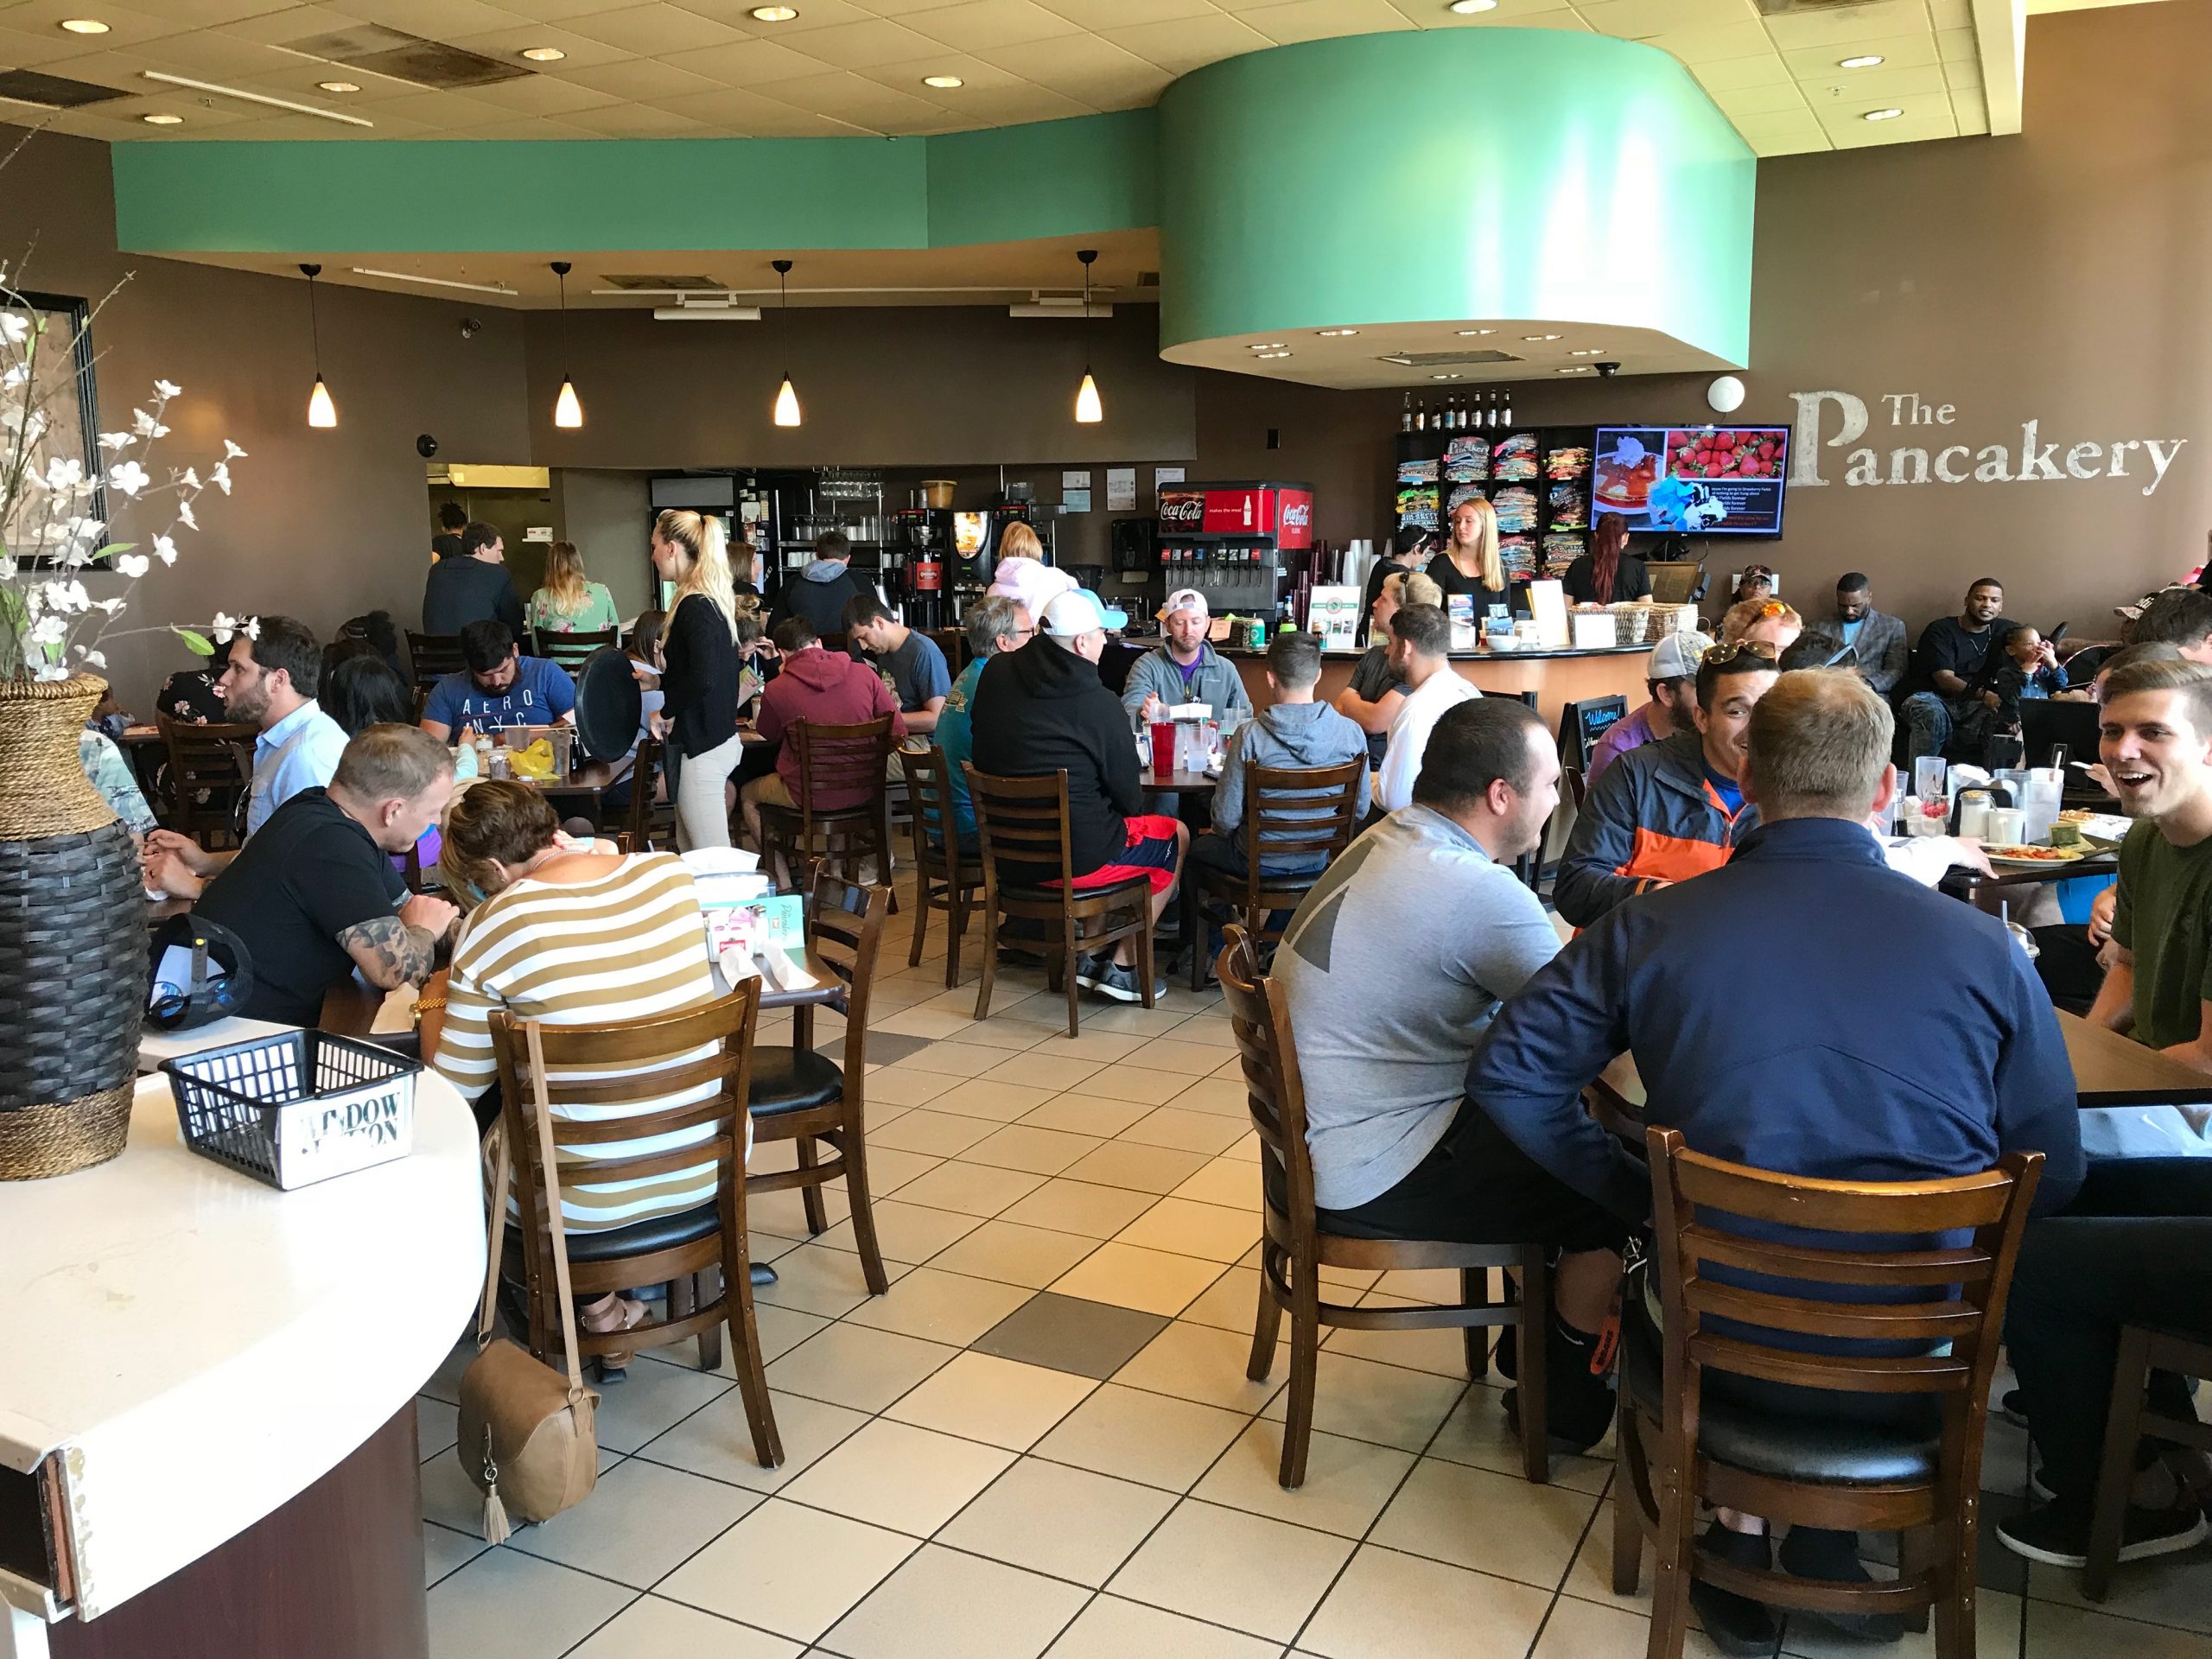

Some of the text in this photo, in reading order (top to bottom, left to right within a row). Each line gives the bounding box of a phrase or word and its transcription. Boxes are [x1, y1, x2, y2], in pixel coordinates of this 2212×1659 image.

[1881, 393, 1956, 425] The
[1787, 391, 2189, 496] Pancakery
[463, 690, 533, 715] AERO
[473, 712, 525, 734] NYC
